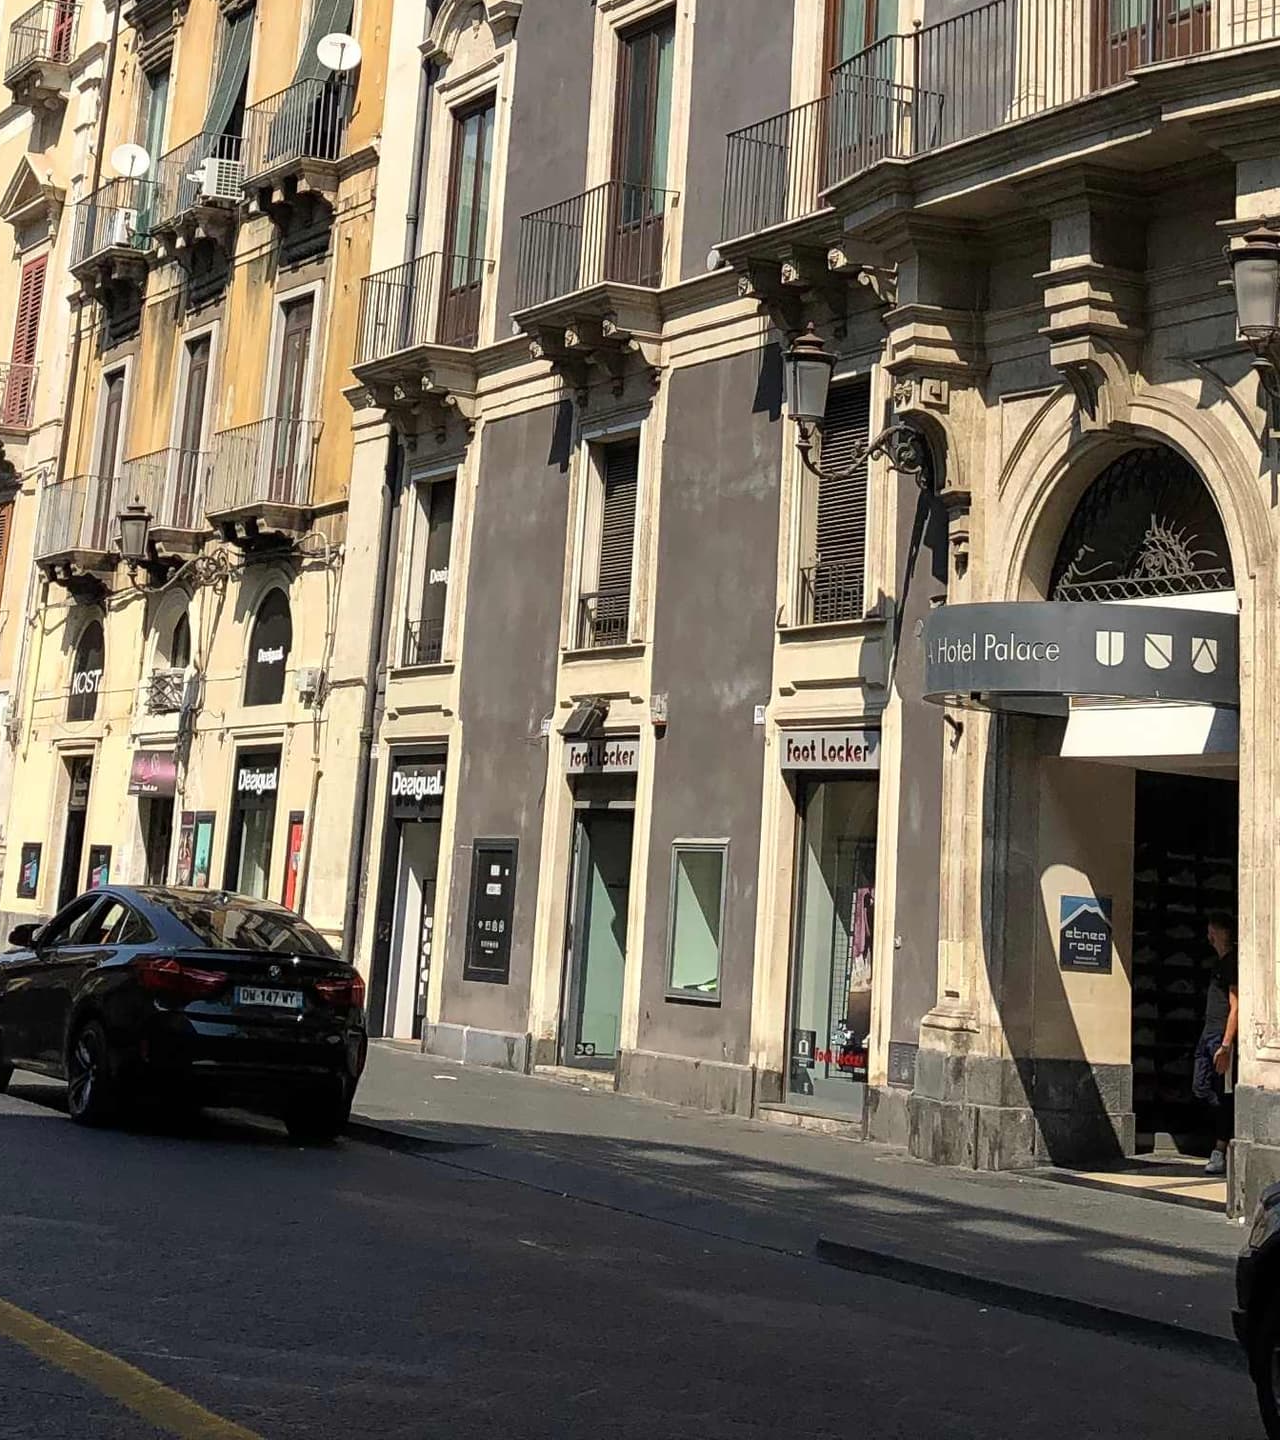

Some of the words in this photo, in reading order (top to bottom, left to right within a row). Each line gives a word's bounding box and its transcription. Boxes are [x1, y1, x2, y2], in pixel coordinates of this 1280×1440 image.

[937, 632, 977, 664] Hotel
[984, 632, 1060, 662] Palace
[71, 669, 102, 695] KOST
[569, 746, 593, 768] Foot
[596, 743, 635, 766] Locker
[786, 737, 817, 763] Foot
[821, 736, 870, 763] Locker
[1065, 926, 1107, 941] etnea
[1069, 942, 1102, 956] roof
